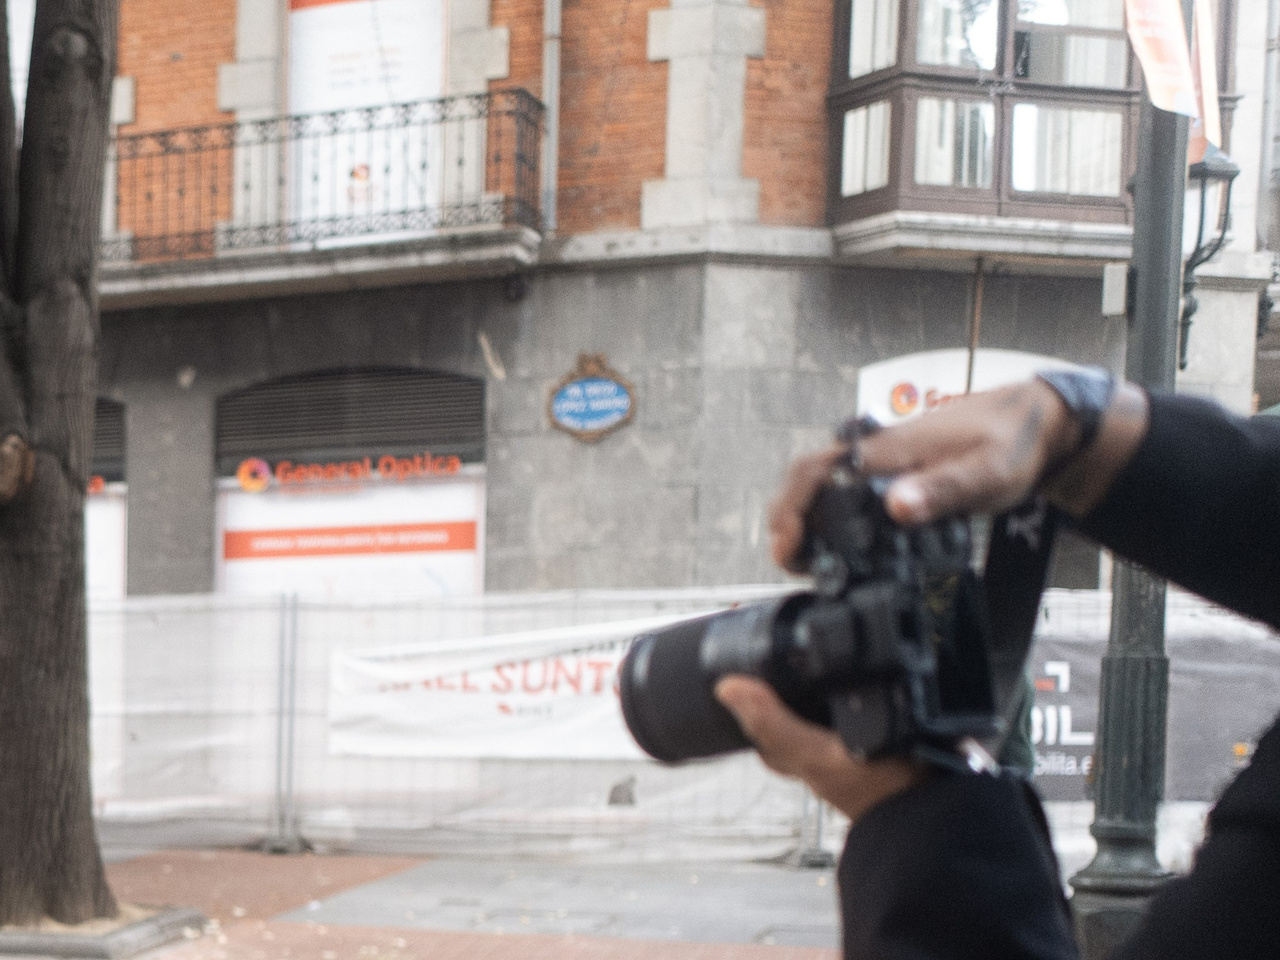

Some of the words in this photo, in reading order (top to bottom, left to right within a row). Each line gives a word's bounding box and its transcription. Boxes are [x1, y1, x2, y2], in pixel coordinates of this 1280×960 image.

[275, 457, 370, 483] General
[378, 452, 461, 481] Optica
[491, 656, 621, 697] SUNT
